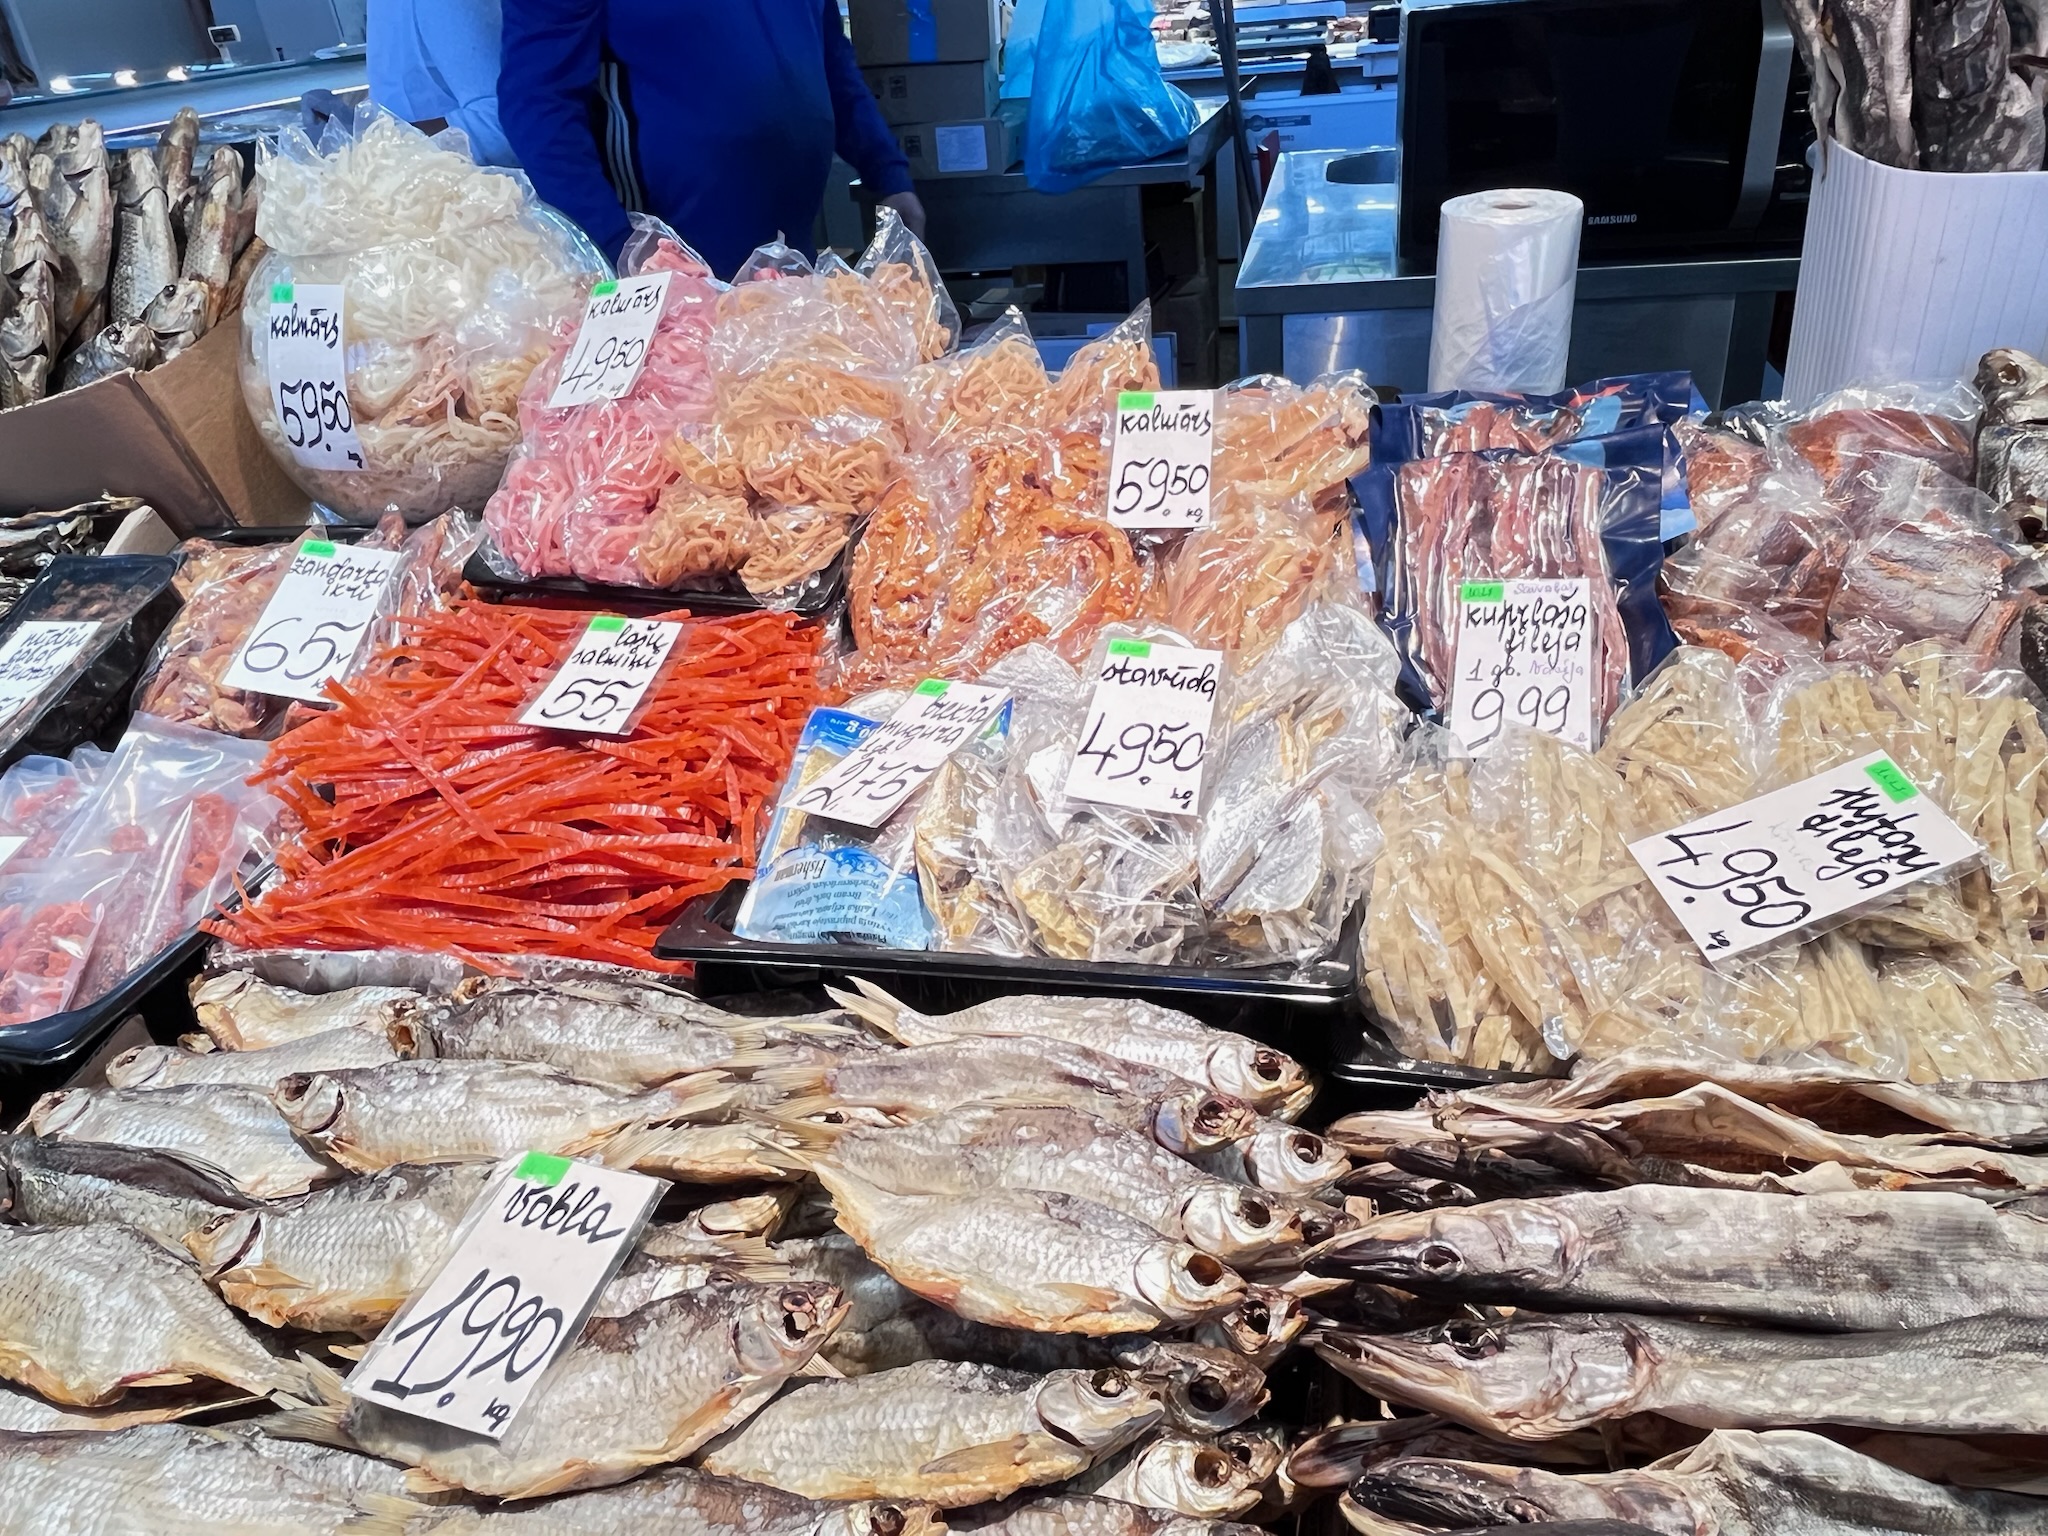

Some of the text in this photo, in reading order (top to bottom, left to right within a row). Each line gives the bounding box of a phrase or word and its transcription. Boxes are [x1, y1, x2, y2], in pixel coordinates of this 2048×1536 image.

[1587, 213, 1638, 225] SAMSUNG
[587, 284, 663, 320] kalmārs
[270, 302, 340, 350] kalmārs
[1119, 403, 1213, 437] kalmārs
[1185, 507, 1204, 523] kg
[1169, 787, 1194, 810] kg
[773, 858, 828, 884] Fisherman
[503, 1181, 627, 1244] vobla
[480, 1396, 512, 1432] kg
